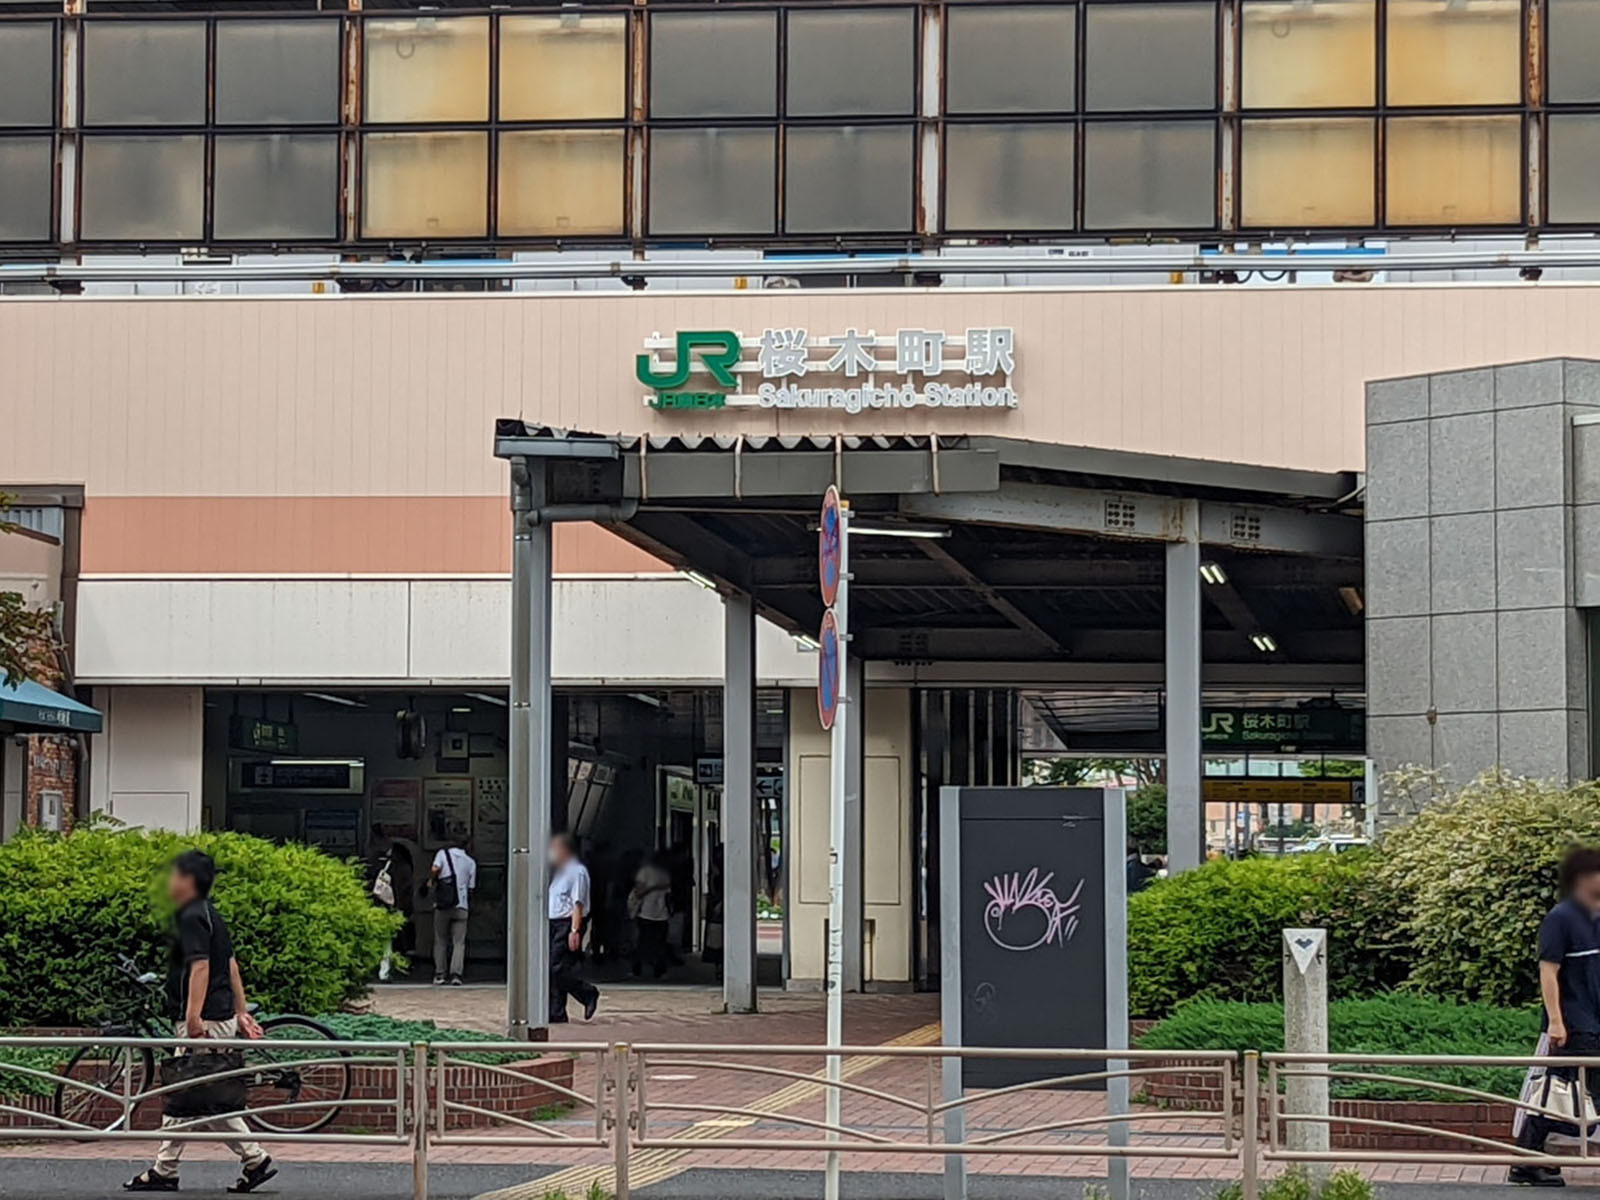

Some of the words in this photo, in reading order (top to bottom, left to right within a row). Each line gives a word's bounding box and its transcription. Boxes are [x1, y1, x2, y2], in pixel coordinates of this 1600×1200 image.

[636, 331, 741, 388] JR
[758, 328, 1015, 377] 桜木町駅
[923, 382, 1014, 408] Station
